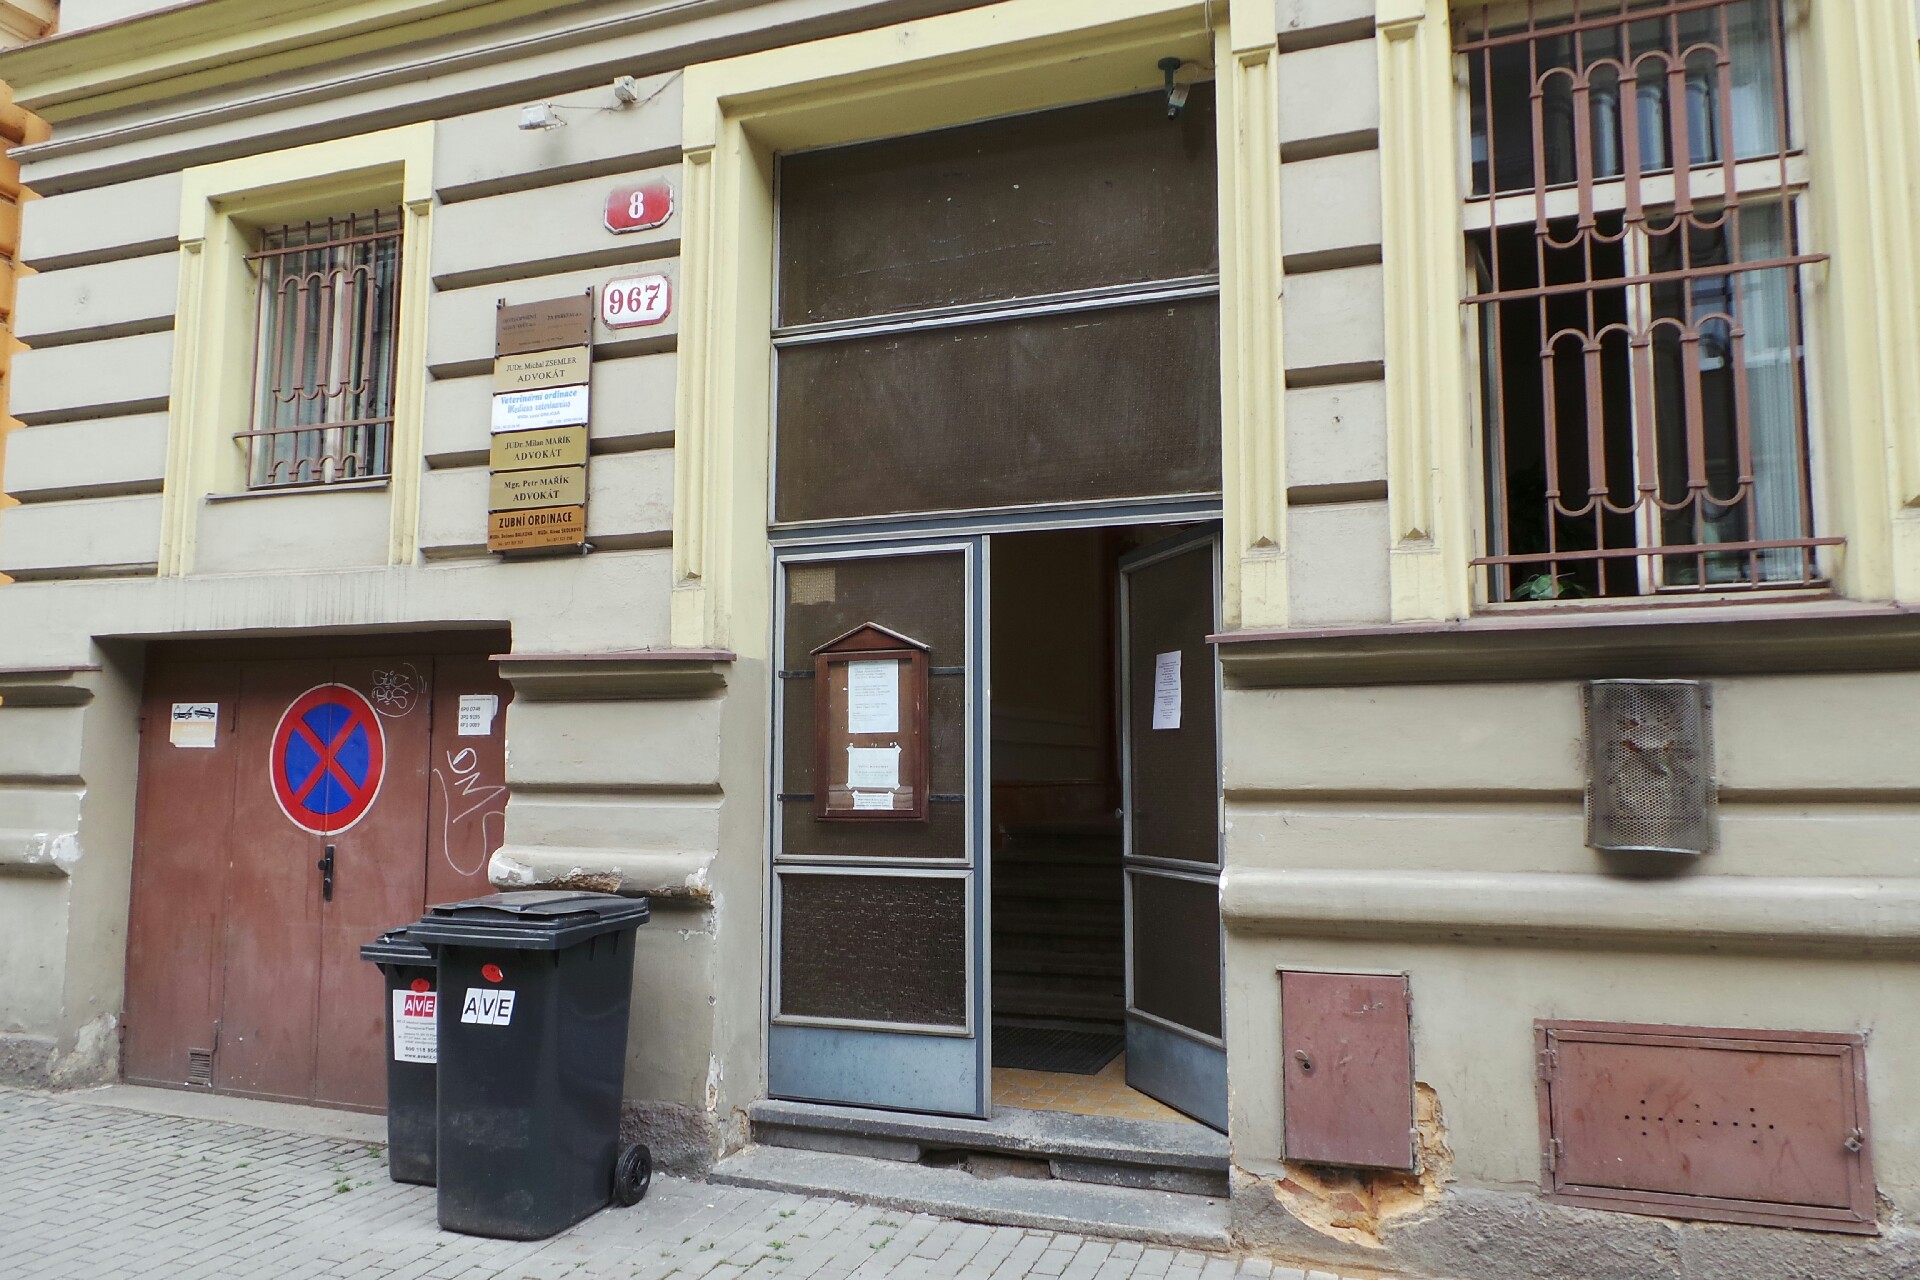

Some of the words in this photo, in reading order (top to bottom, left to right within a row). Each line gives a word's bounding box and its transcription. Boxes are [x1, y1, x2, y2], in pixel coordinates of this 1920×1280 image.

[629, 191, 644, 219] 8
[609, 283, 660, 315] 967
[524, 361, 544, 370] Michal
[545, 357, 577, 367] ZSEMLER
[517, 369, 566, 382] ADVOKÁT
[544, 389, 578, 400] ordinace
[505, 441, 524, 450] JUDr.
[525, 439, 544, 448] Milan
[513, 448, 562, 461] ADVOKÁT
[504, 480, 520, 490] Mgr.
[523, 479, 538, 488] Petr
[540, 475, 570, 486] MAŘÍK
[513, 489, 560, 502] ADVOKÁT
[499, 513, 526, 529] ZUBNÍ
[528, 511, 572, 526] ORDINACE
[405, 999, 434, 1013] AVE
[464, 997, 511, 1017] AVE
